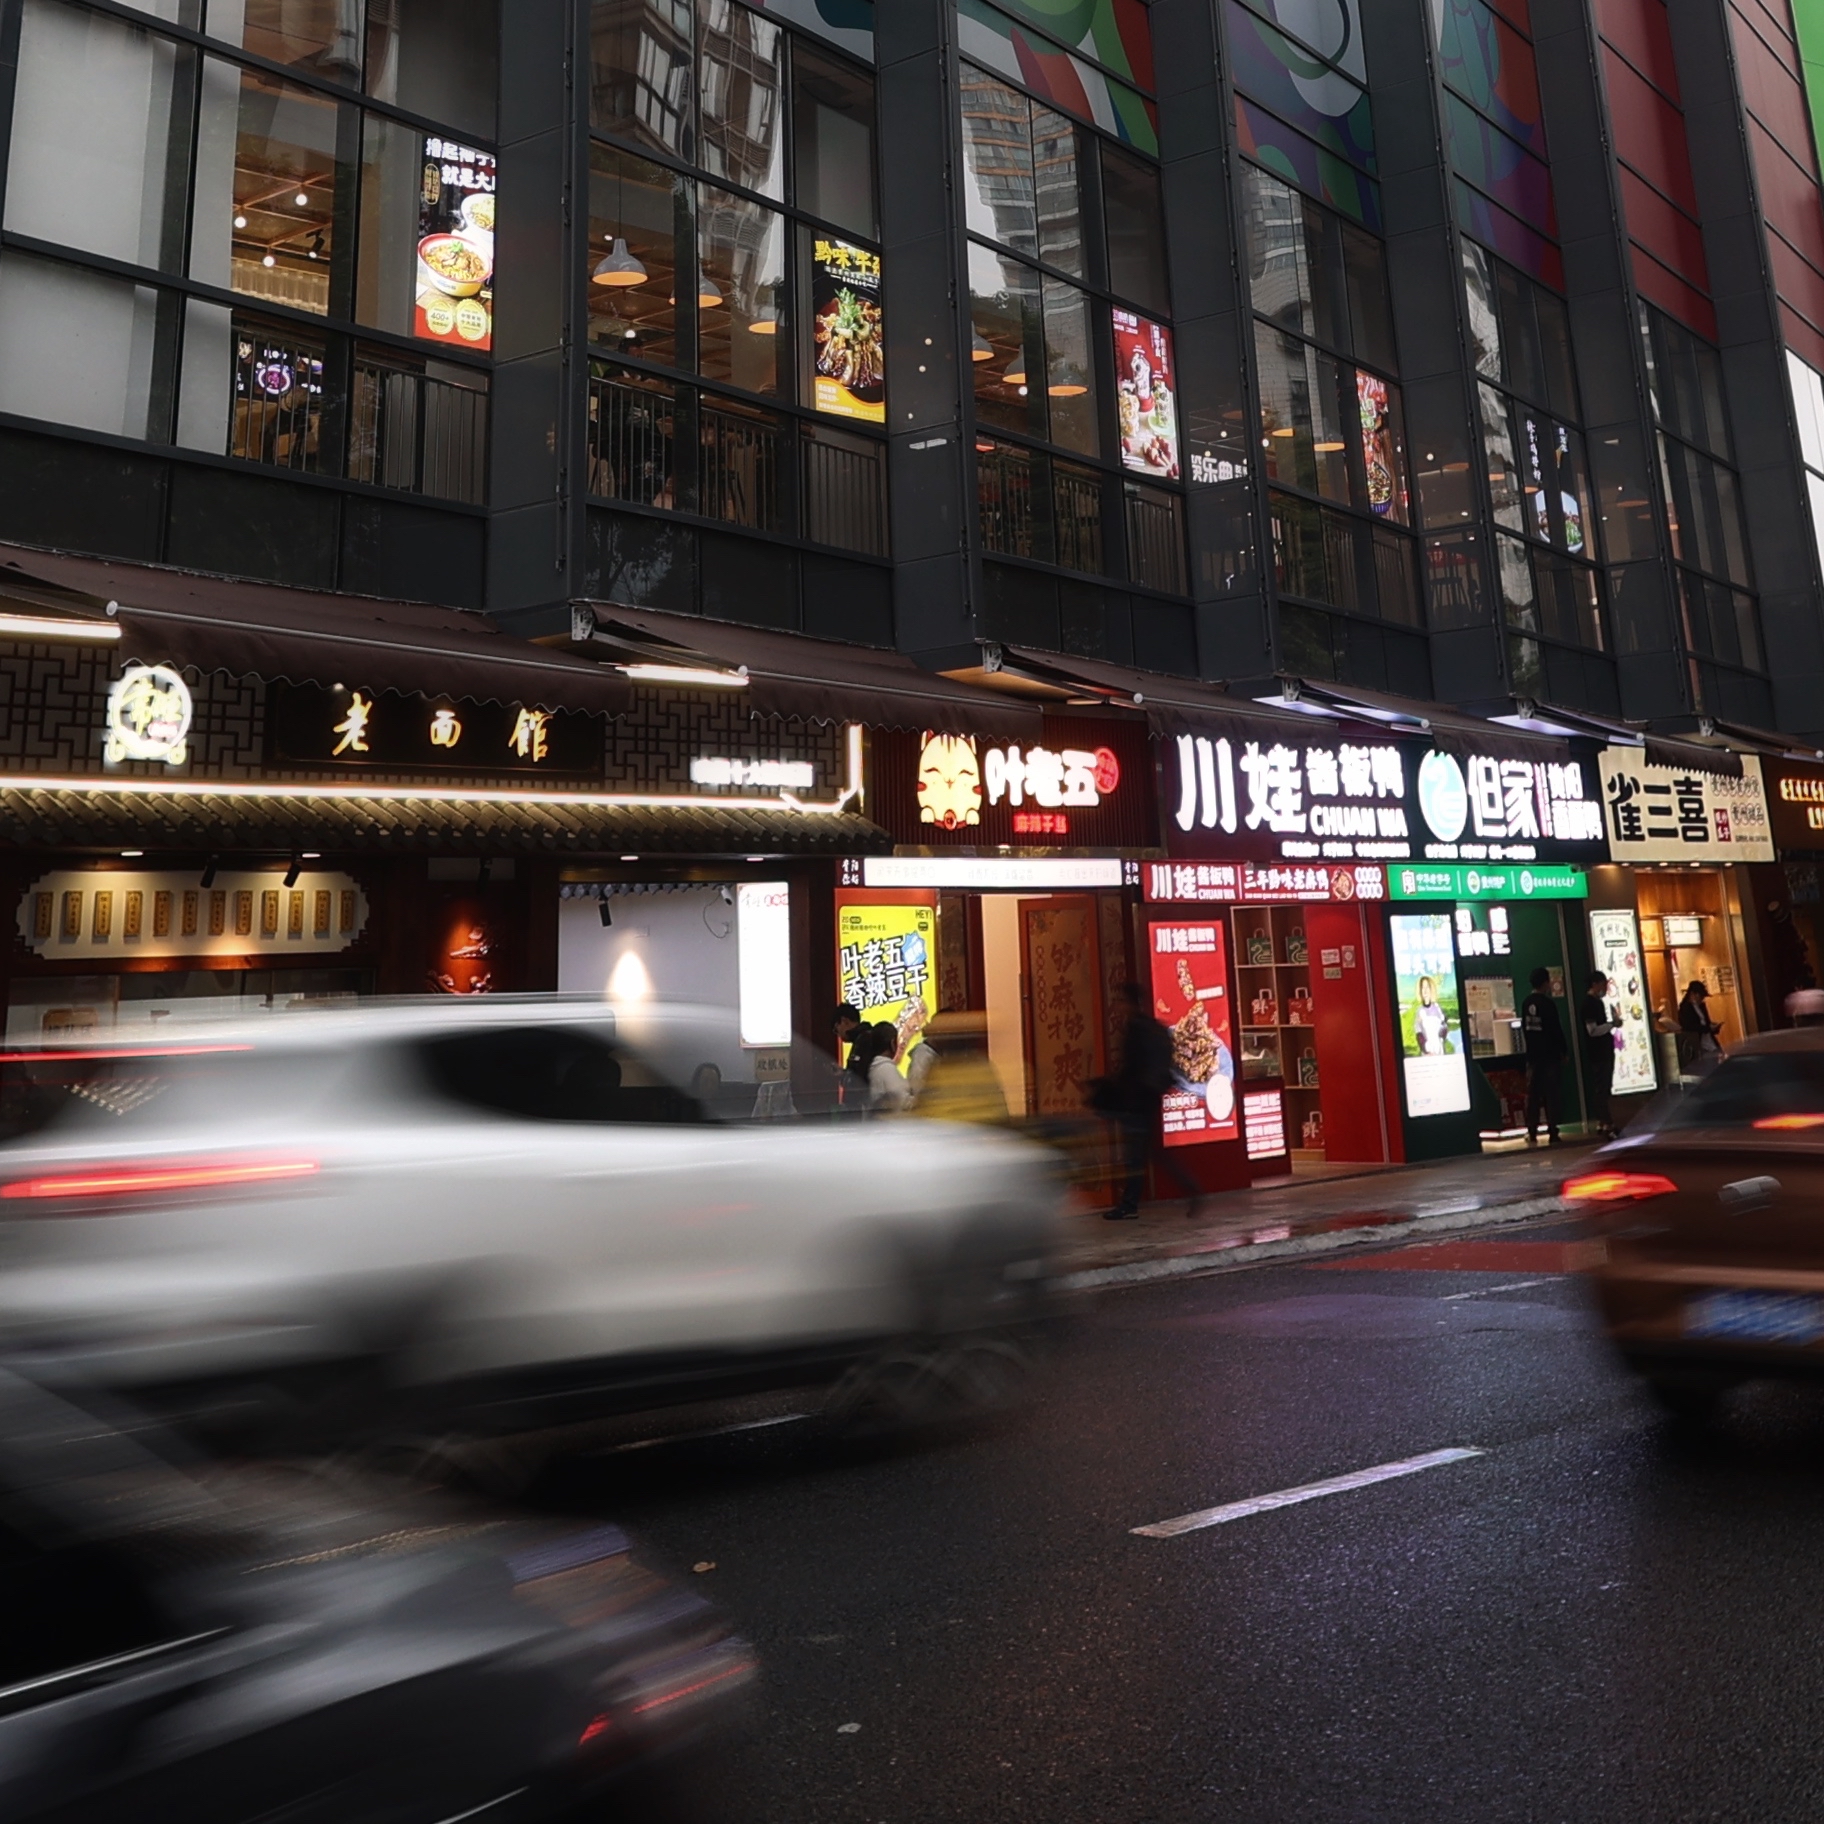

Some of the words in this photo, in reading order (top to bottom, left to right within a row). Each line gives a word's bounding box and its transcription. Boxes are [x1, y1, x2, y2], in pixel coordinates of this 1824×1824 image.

[984, 745, 1100, 807] 叶老五
[1175, 733, 1307, 834] 川娃
[1309, 805, 1378, 838] CHUAN
[1376, 807, 1409, 837] WA
[1150, 863, 1198, 900] 川娃
[840, 937, 905, 976] 叶老五
[843, 963, 928, 1012] 香辣豆干
